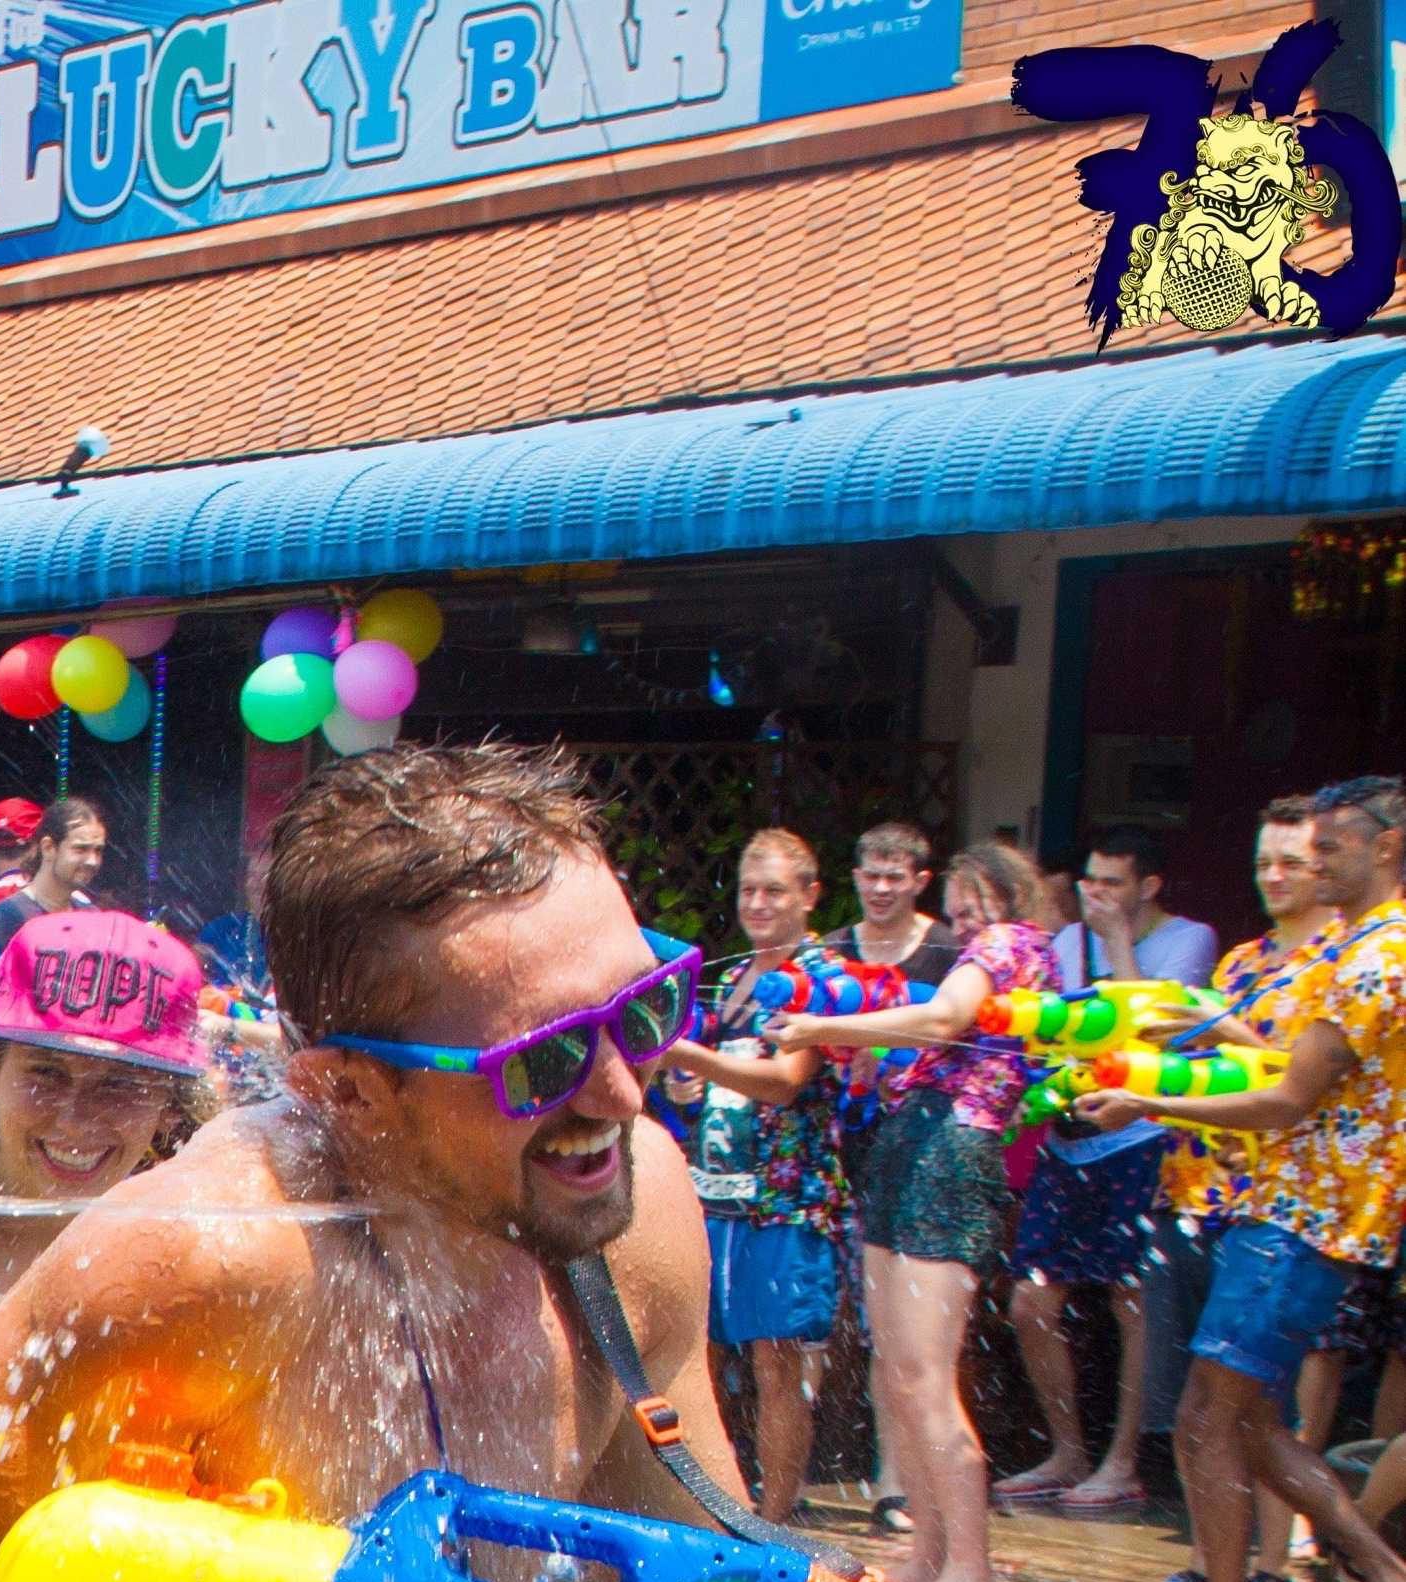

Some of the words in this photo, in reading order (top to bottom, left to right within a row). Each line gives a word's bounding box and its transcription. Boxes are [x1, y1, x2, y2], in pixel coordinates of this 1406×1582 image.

[453, 0, 729, 150] BAR
[798, 32, 865, 51] DRINKING
[871, 14, 922, 36] WATER
